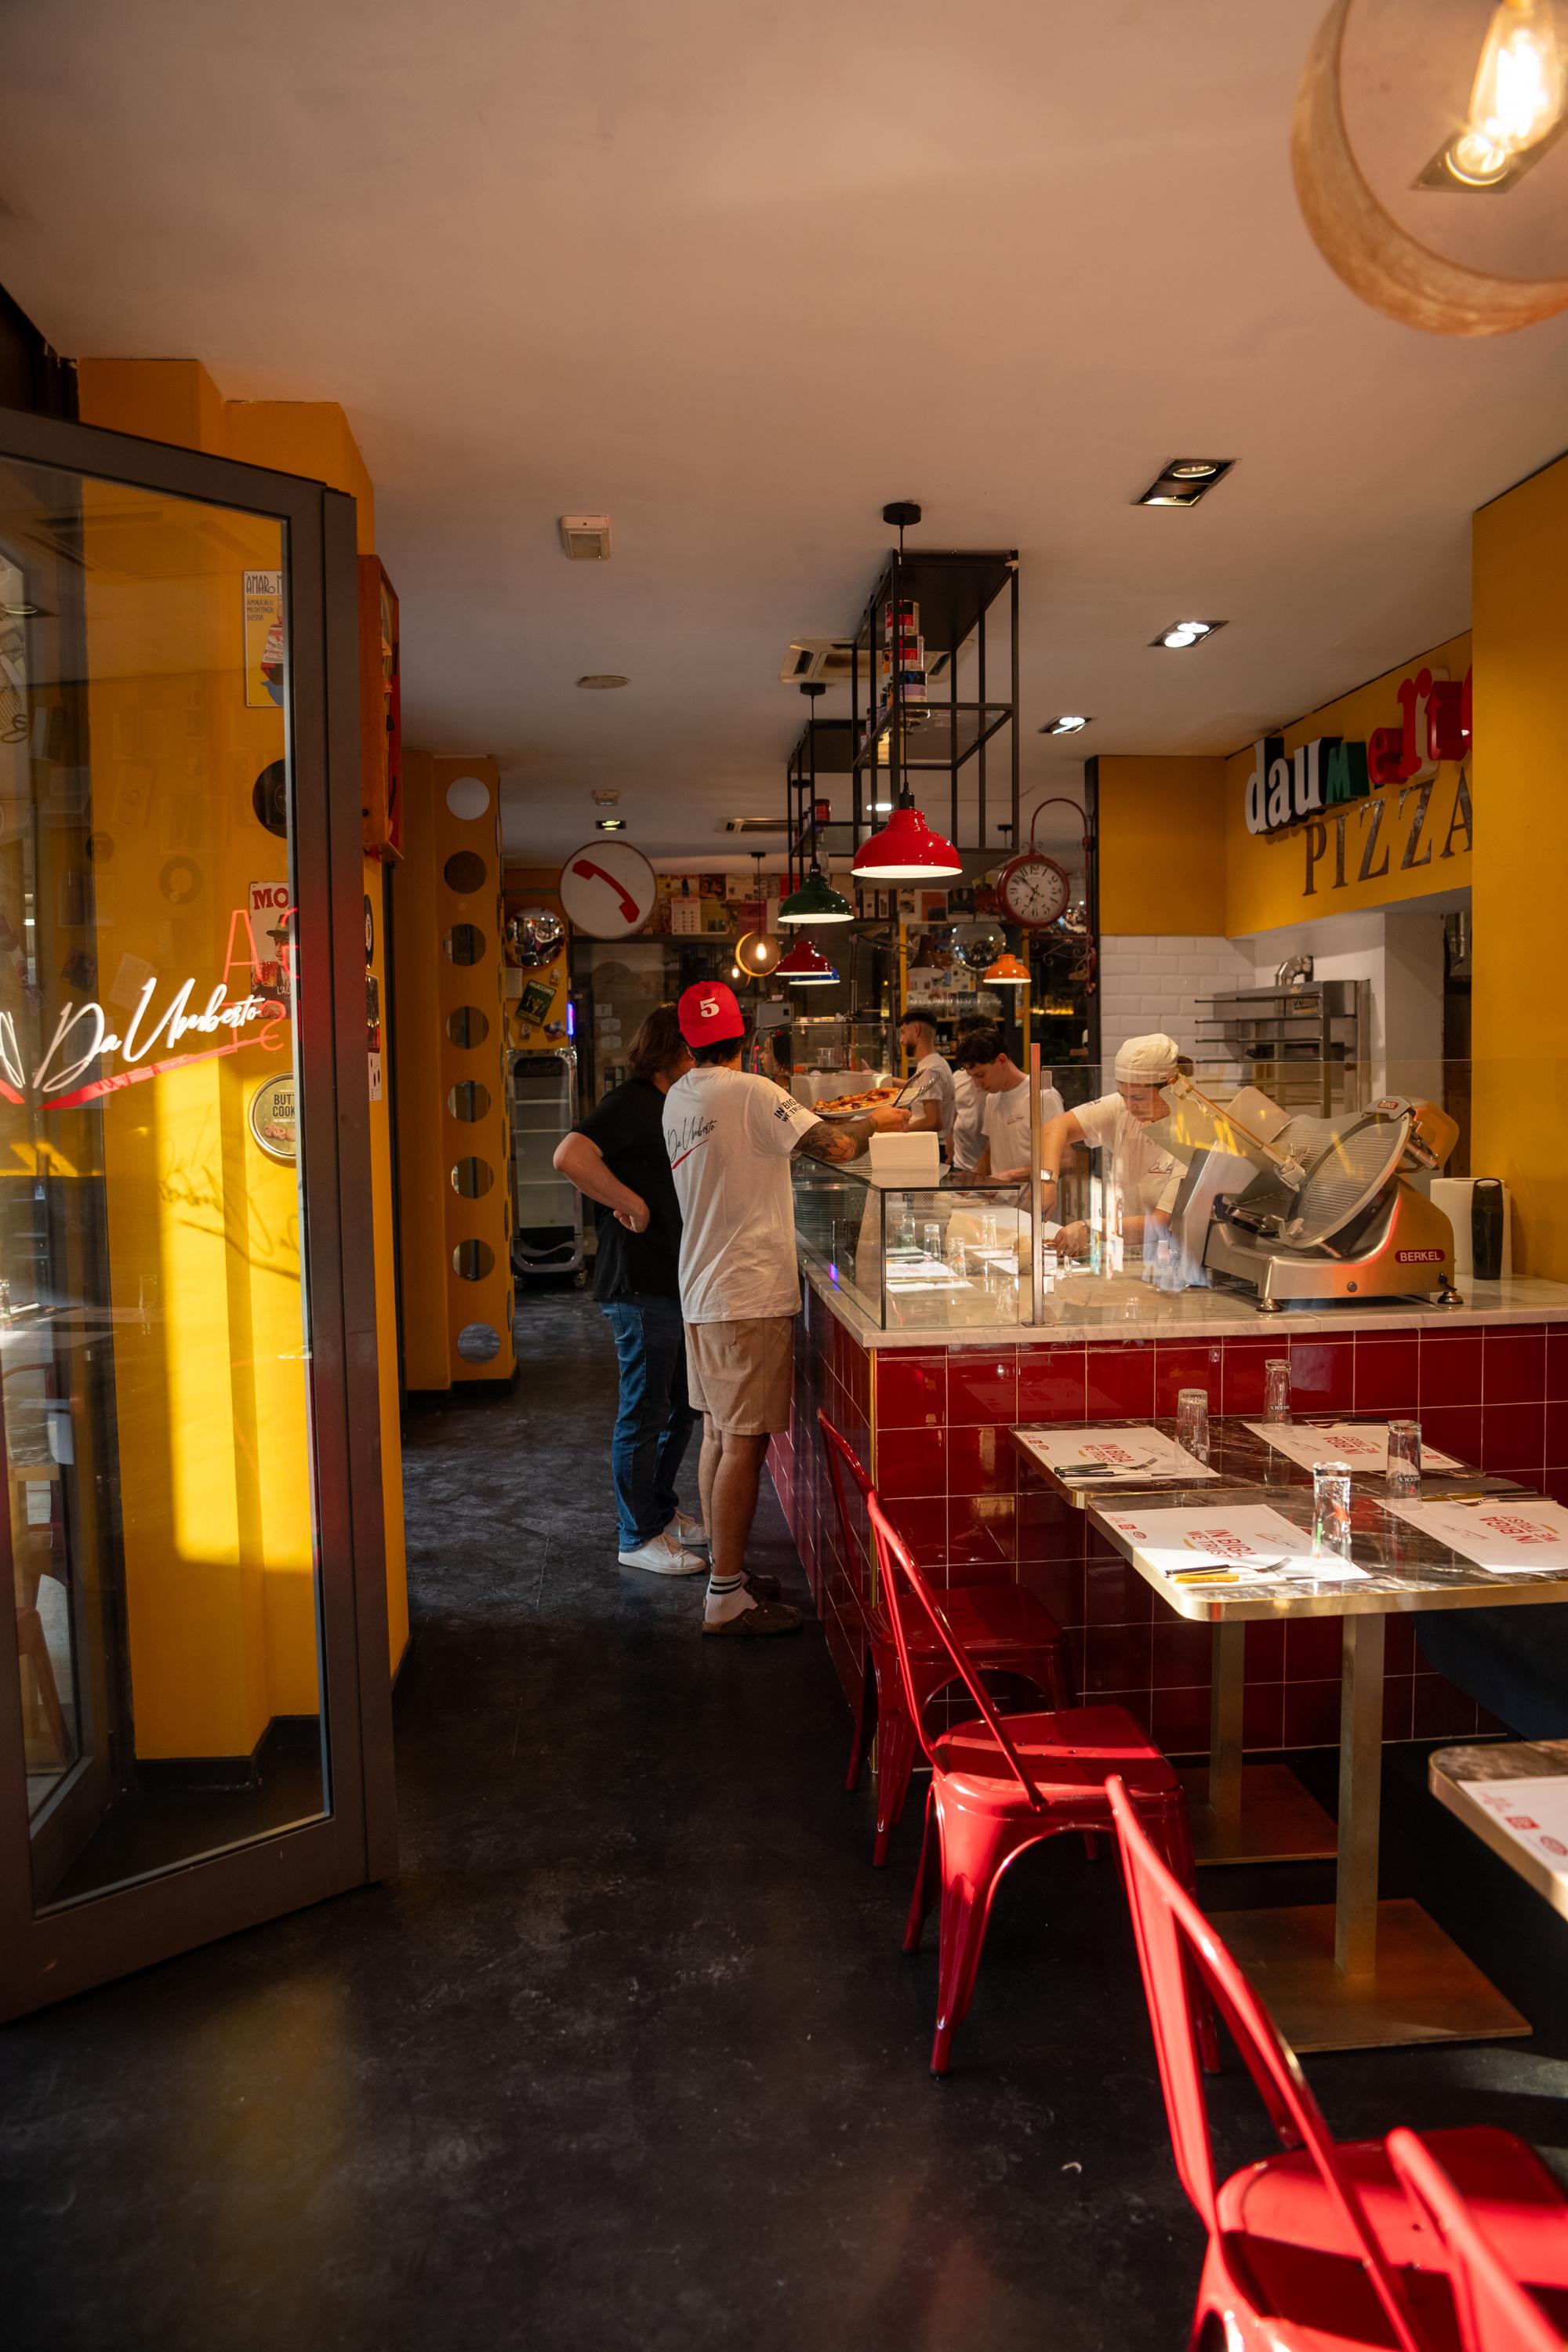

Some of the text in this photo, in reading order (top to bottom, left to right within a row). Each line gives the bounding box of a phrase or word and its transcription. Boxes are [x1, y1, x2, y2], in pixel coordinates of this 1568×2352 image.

[246, 575, 276, 594] AMARO
[1302, 766, 1472, 896] PIZZA
[252, 887, 289, 910] MO
[699, 997, 720, 1018] 5
[33, 1001, 122, 1092] Da
[122, 977, 266, 1062] Umberto
[274, 1094, 295, 1105] BUT
[774, 1098, 798, 1119] IN BIG
[273, 1105, 296, 1117] COOK
[782, 1112, 792, 1122] WE
[667, 1116, 718, 1163] Da Umberto
[1399, 1250, 1441, 1262] BERKEL
[1323, 1436, 1352, 1449] BIGA
[1342, 1446, 1366, 1455] IN
[1106, 1450, 1136, 1463] BIGA
[1479, 1516, 1524, 1535] BIGA
[1500, 1515, 1562, 1544] WE TRUST
[1185, 1530, 1232, 1559] WE TRUST
[1204, 1529, 1226, 1537] IN
[1217, 1538, 1258, 1558] BIGA
